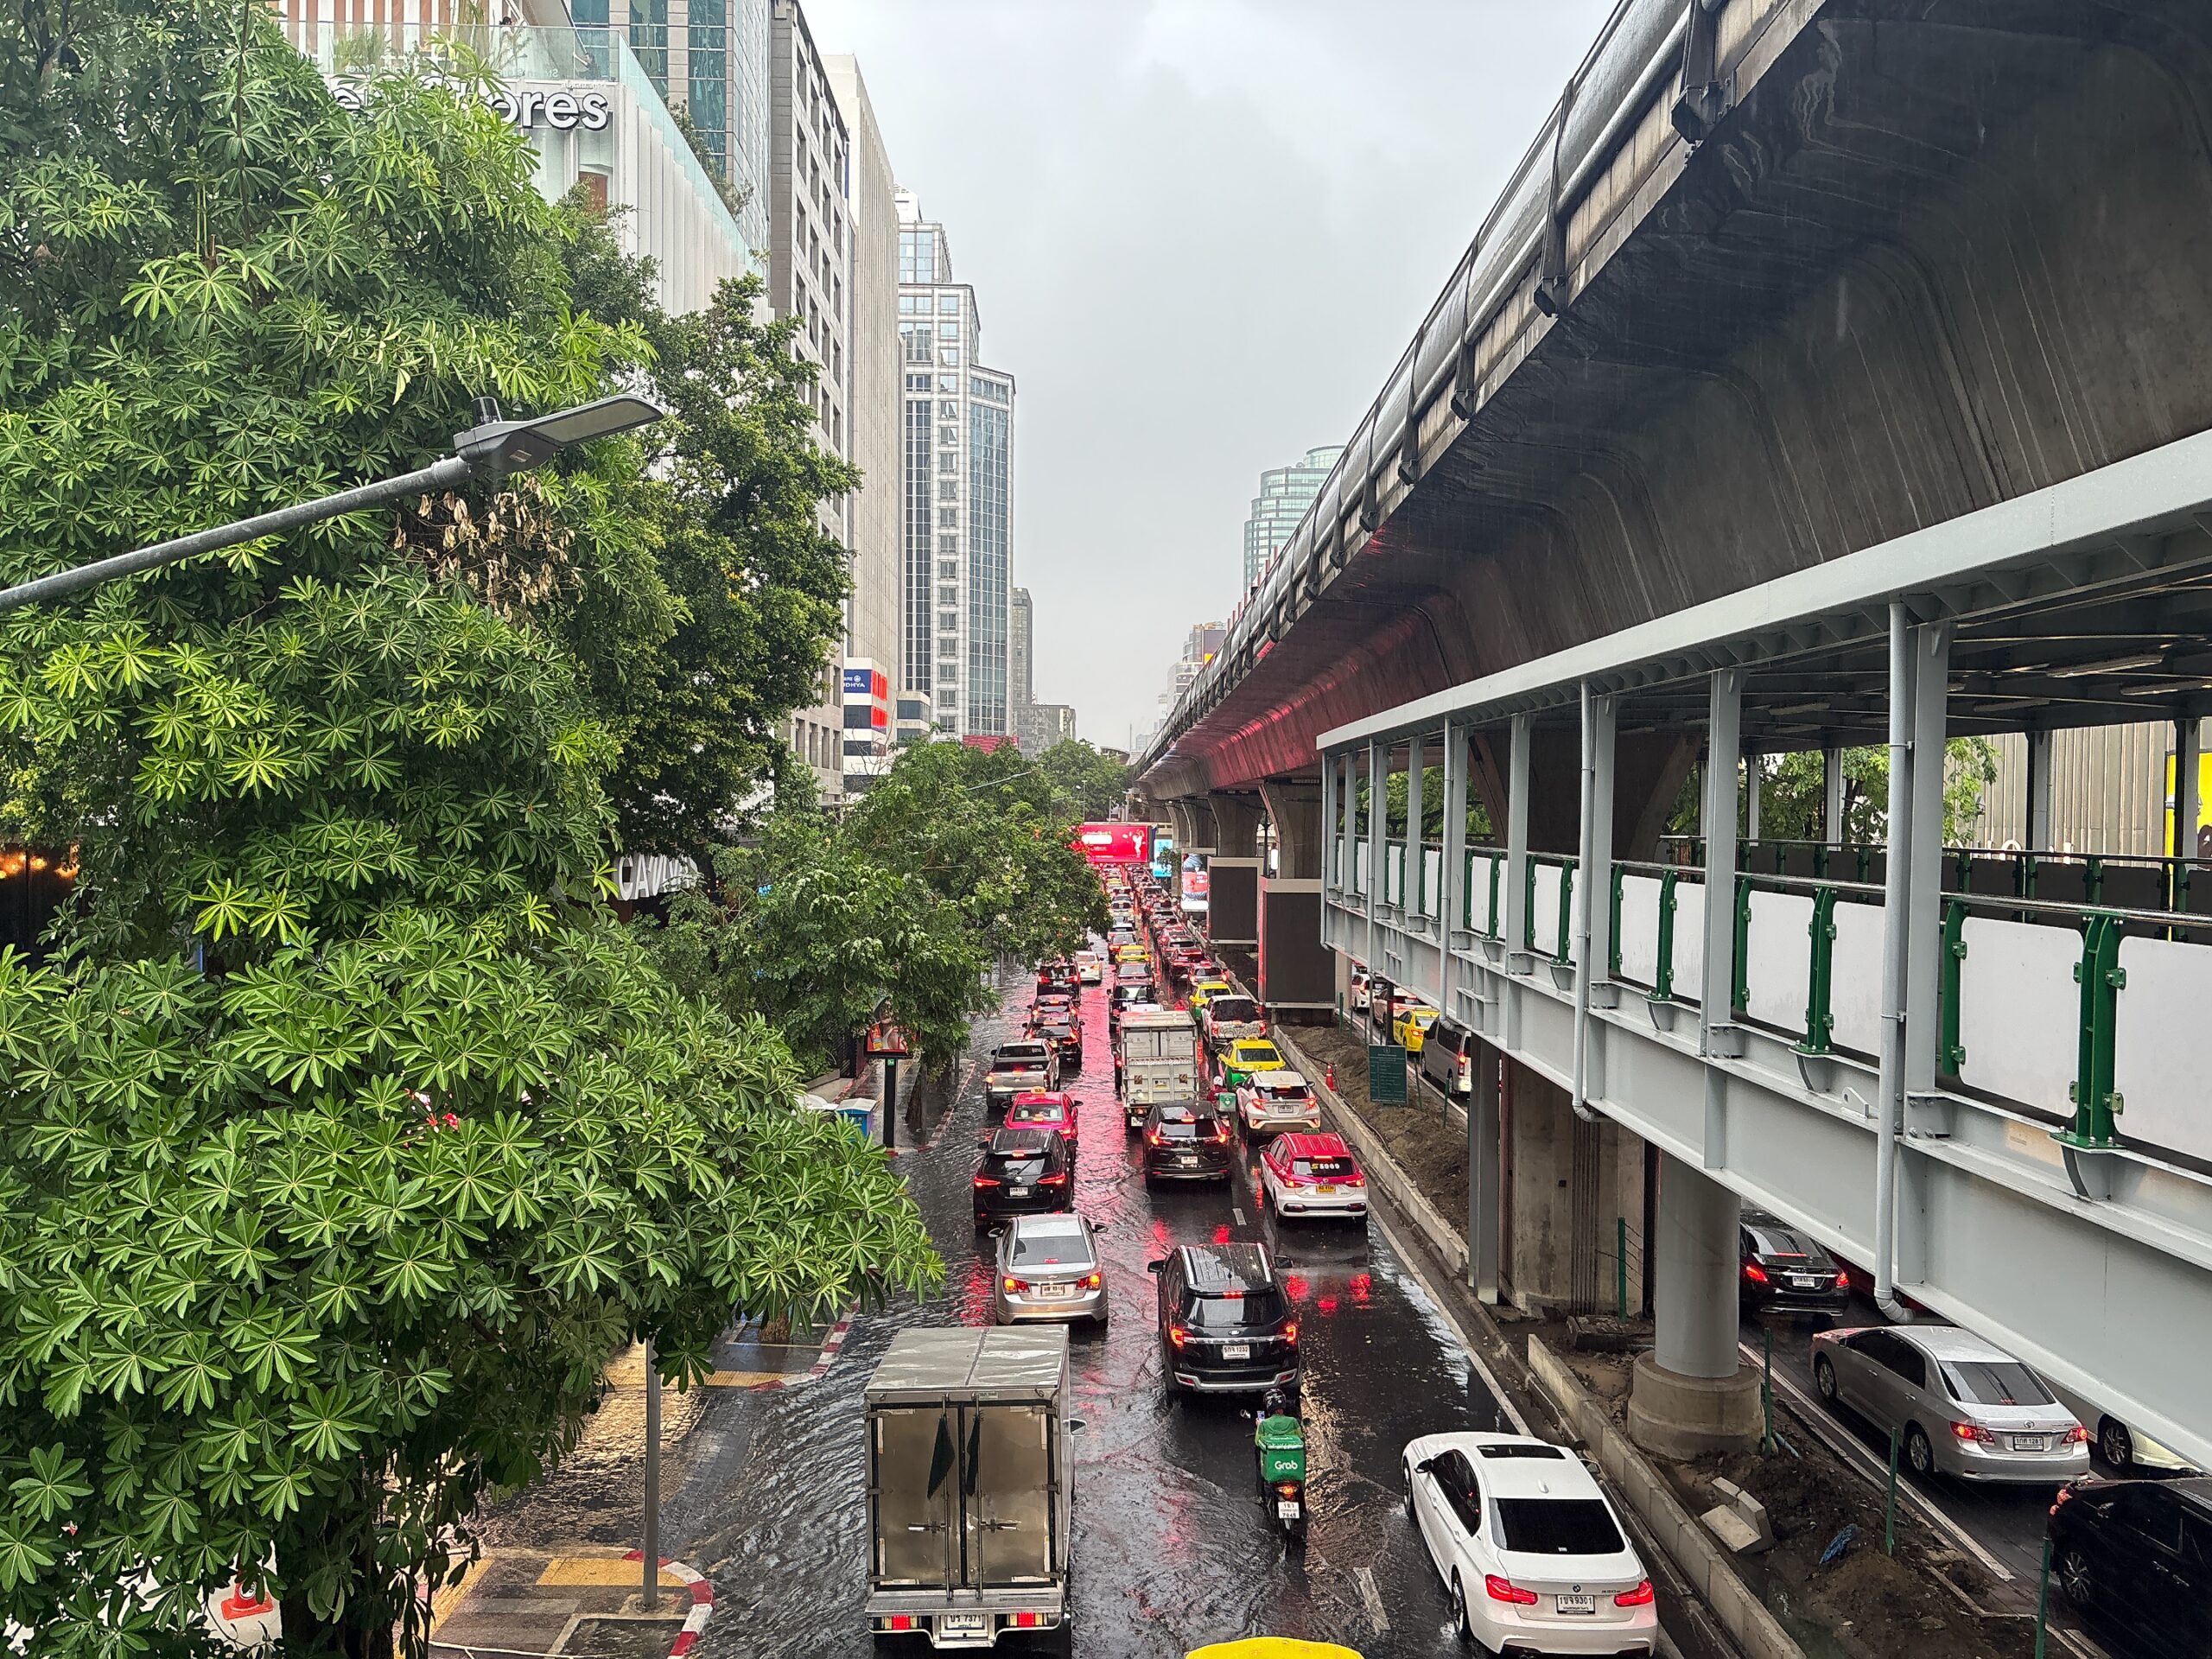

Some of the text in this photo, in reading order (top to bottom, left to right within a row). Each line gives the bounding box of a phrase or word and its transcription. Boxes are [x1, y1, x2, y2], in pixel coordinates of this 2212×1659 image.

[1274, 1460, 1298, 1470] Grab
[1574, 1596, 1592, 1605] 9301
[963, 1614, 982, 1623] 7371
